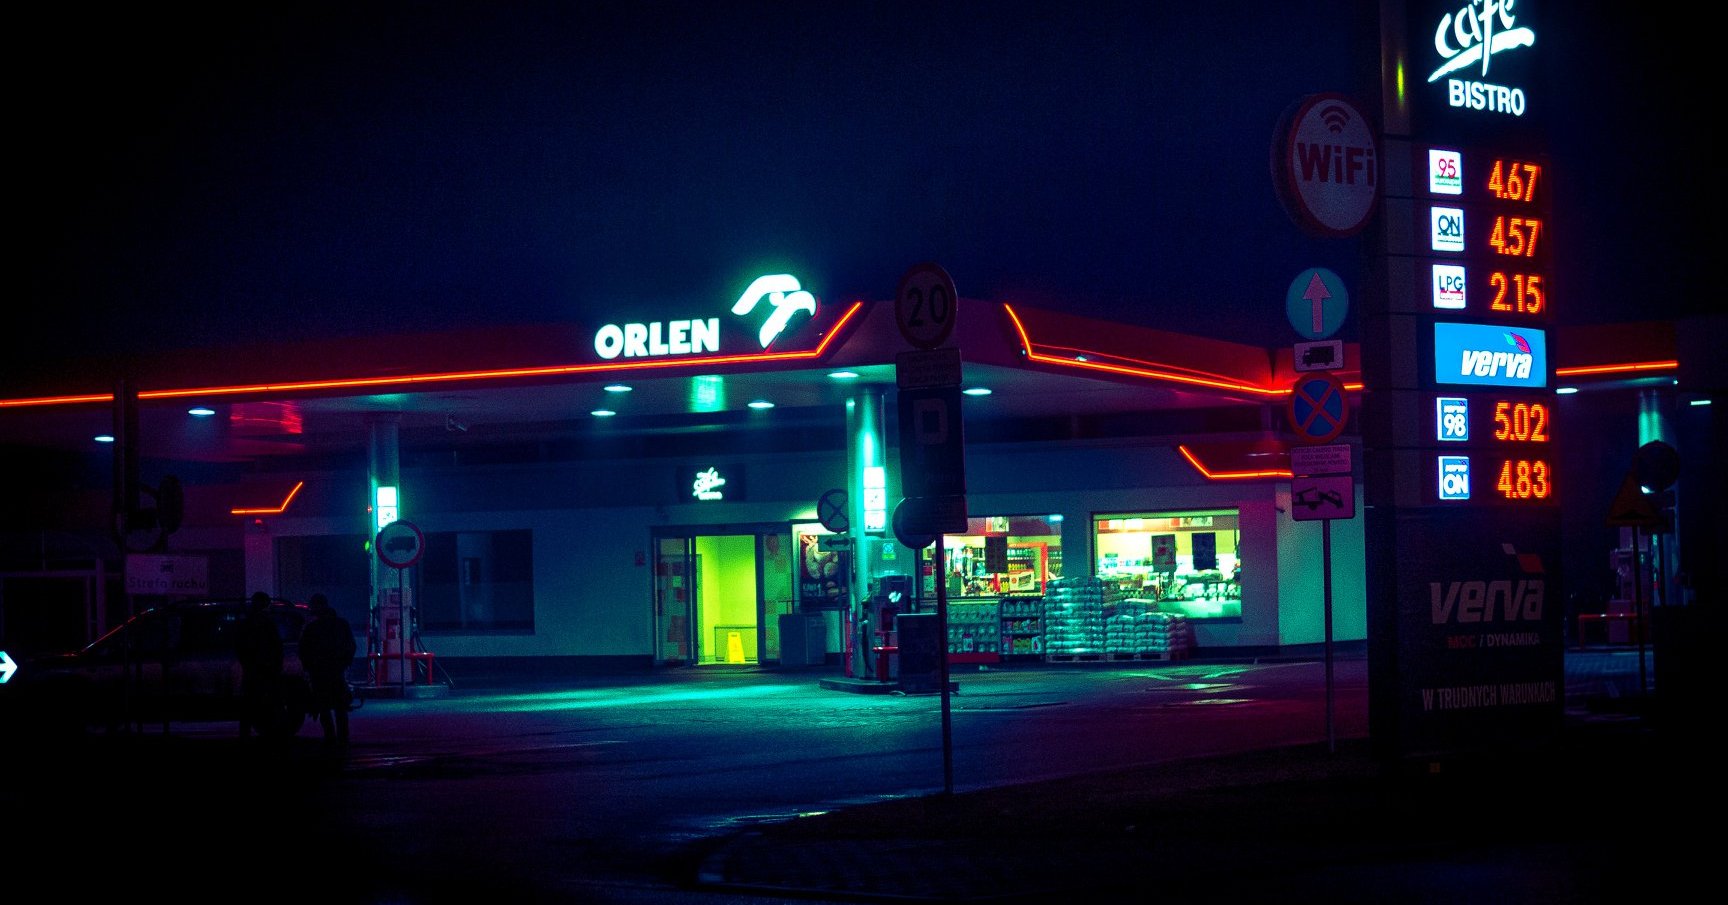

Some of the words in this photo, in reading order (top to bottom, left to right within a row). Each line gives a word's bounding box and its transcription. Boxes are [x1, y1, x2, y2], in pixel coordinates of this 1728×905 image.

[1449, 79, 1525, 116] BISTRO
[1297, 142, 1374, 188] WiFi
[1438, 158, 1457, 179] 95
[1488, 159, 1542, 203] 4.67
[1438, 214, 1460, 236] ON
[1489, 214, 1543, 258] 4.57
[1439, 275, 1463, 291] LPG
[1489, 271, 1544, 314] 2.15
[906, 283, 948, 328] 20
[594, 317, 720, 360] ORLEN
[1460, 348, 1533, 380] verva
[913, 398, 949, 465] P
[1443, 413, 1467, 437] 98
[1494, 401, 1549, 443] 5.02
[1443, 473, 1469, 495] ON
[1496, 459, 1550, 500] 4.83
[1429, 579, 1545, 625] verva
[1486, 631, 1541, 648] DYNAMIKA
[1421, 687, 1434, 712] W
[1437, 683, 1497, 711] TRUDNYCH
[1500, 680, 1556, 706] WARUNKACH
